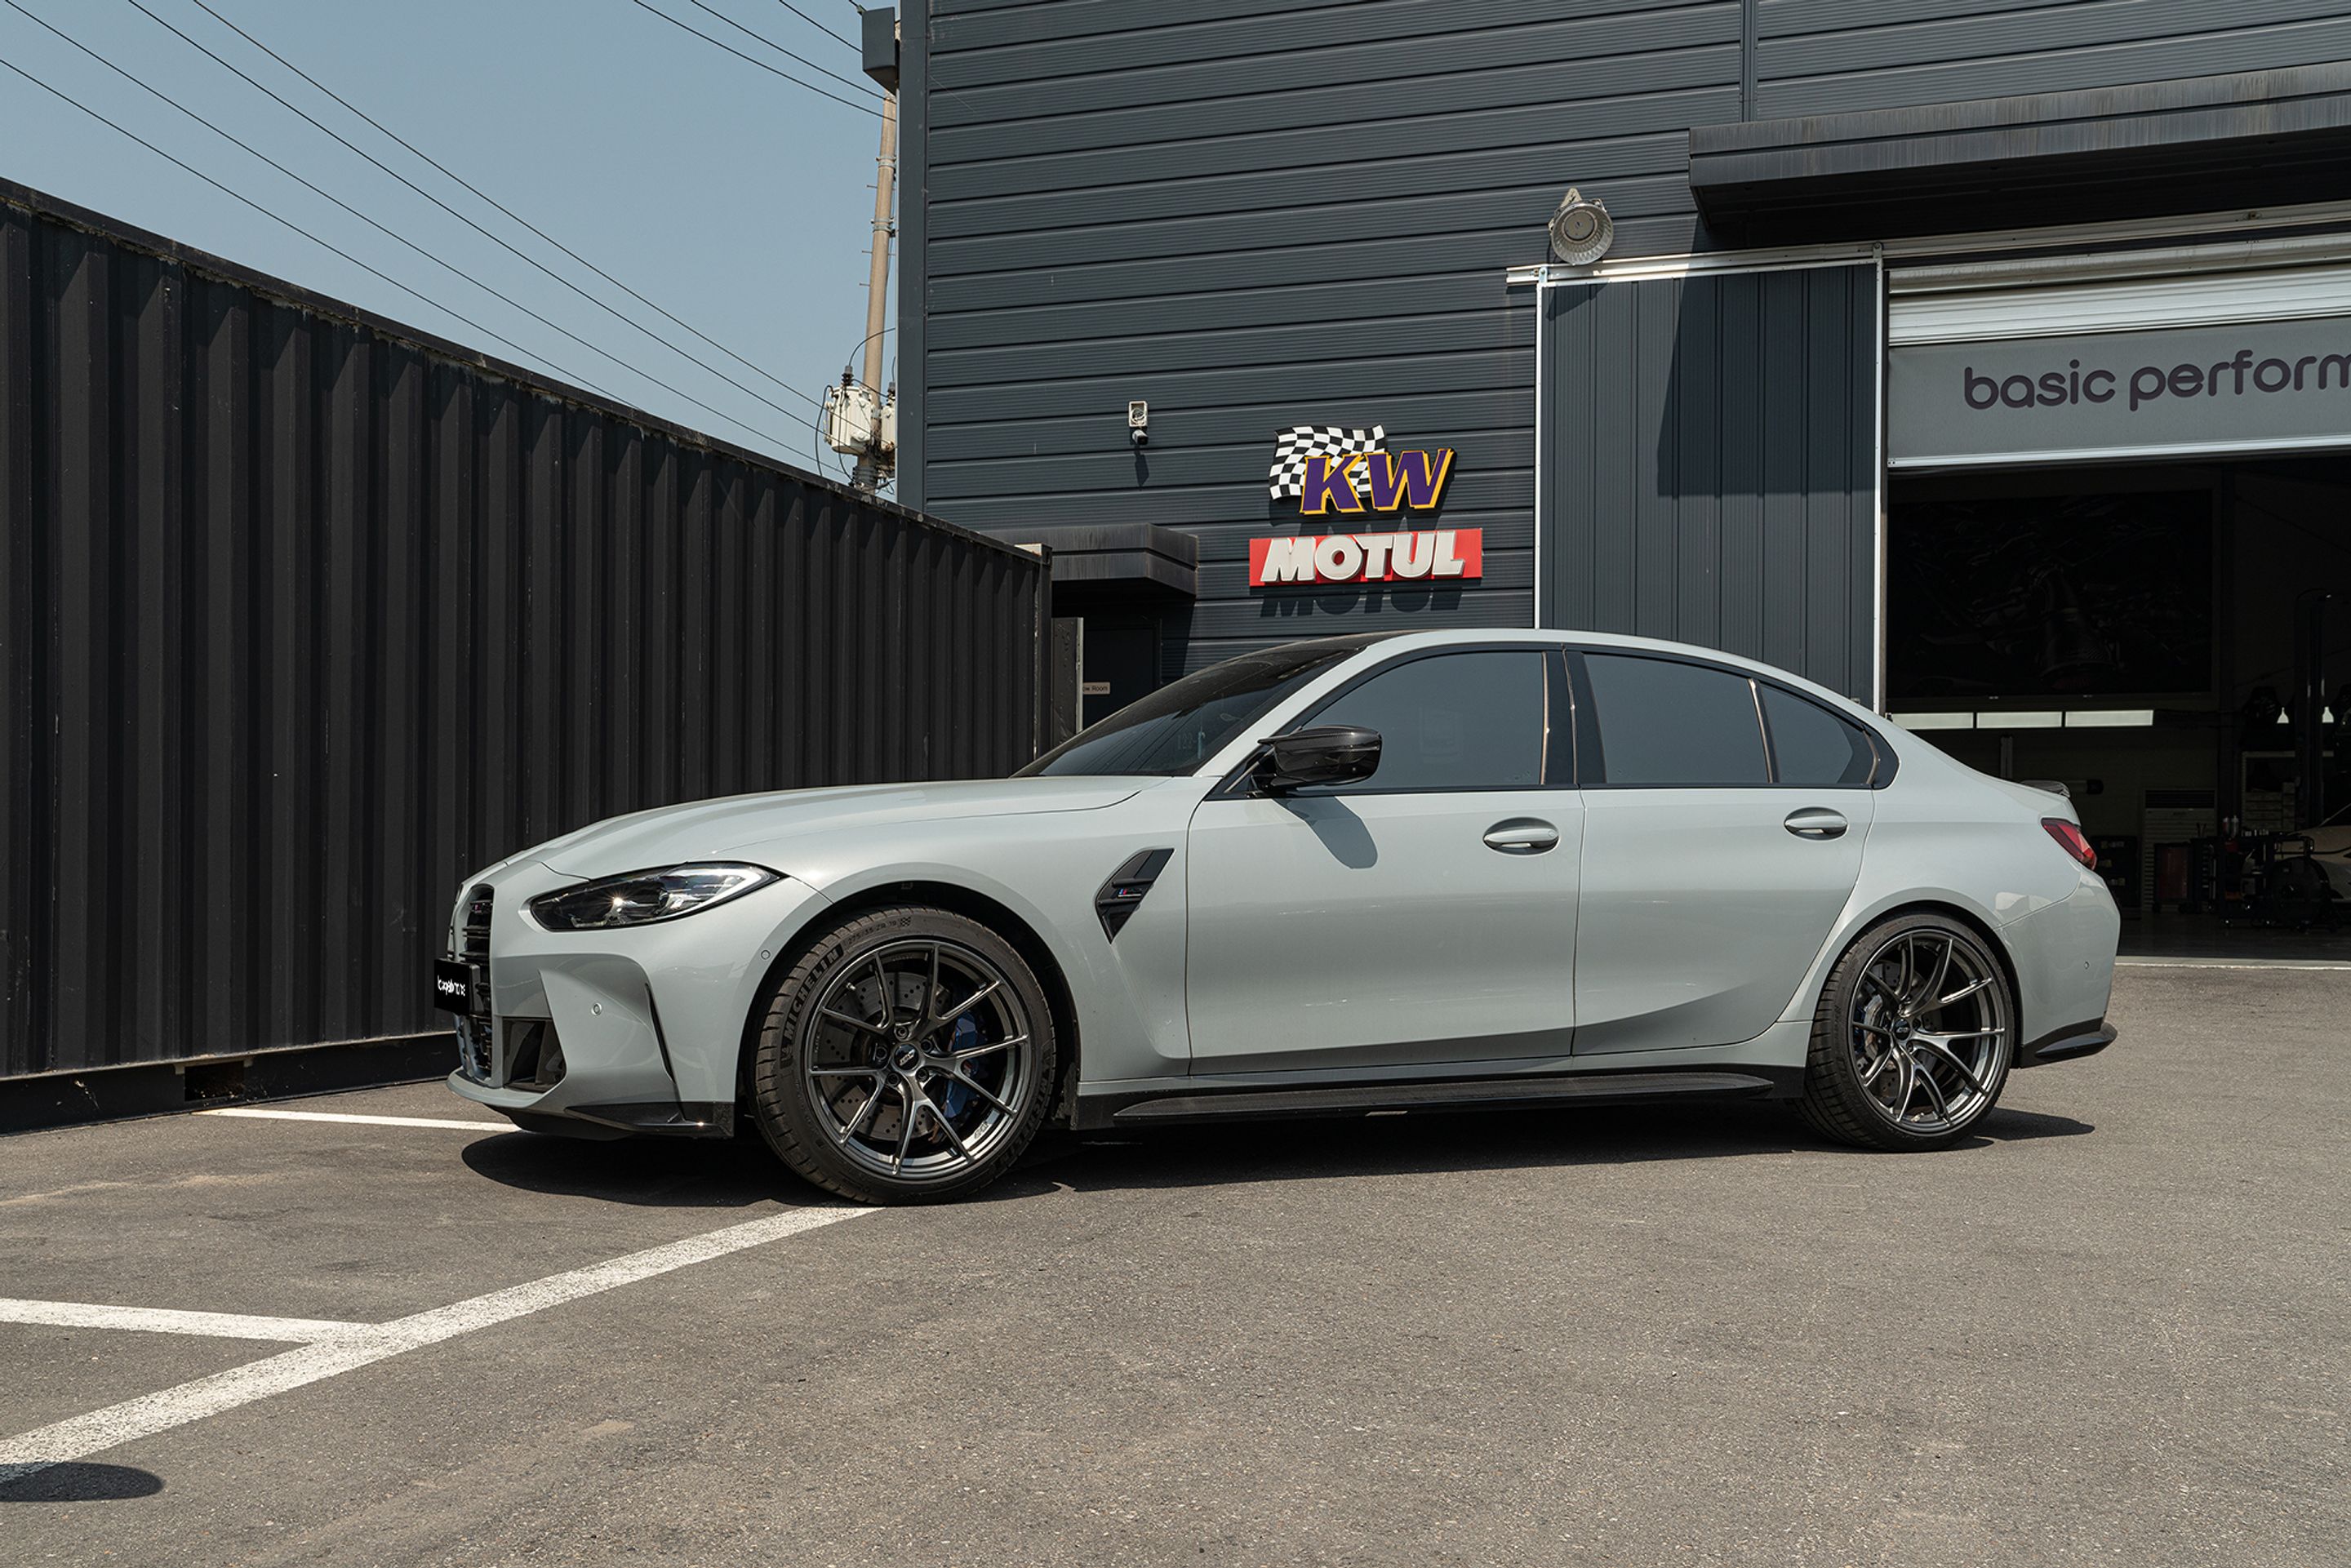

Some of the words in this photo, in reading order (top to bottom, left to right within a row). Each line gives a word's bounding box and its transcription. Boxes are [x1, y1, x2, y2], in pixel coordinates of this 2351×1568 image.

[1964, 359, 2116, 410] basic
[1300, 448, 1454, 515] KW
[1260, 531, 1465, 582] MOTUL
[783, 948, 840, 1040] MICHELIN
